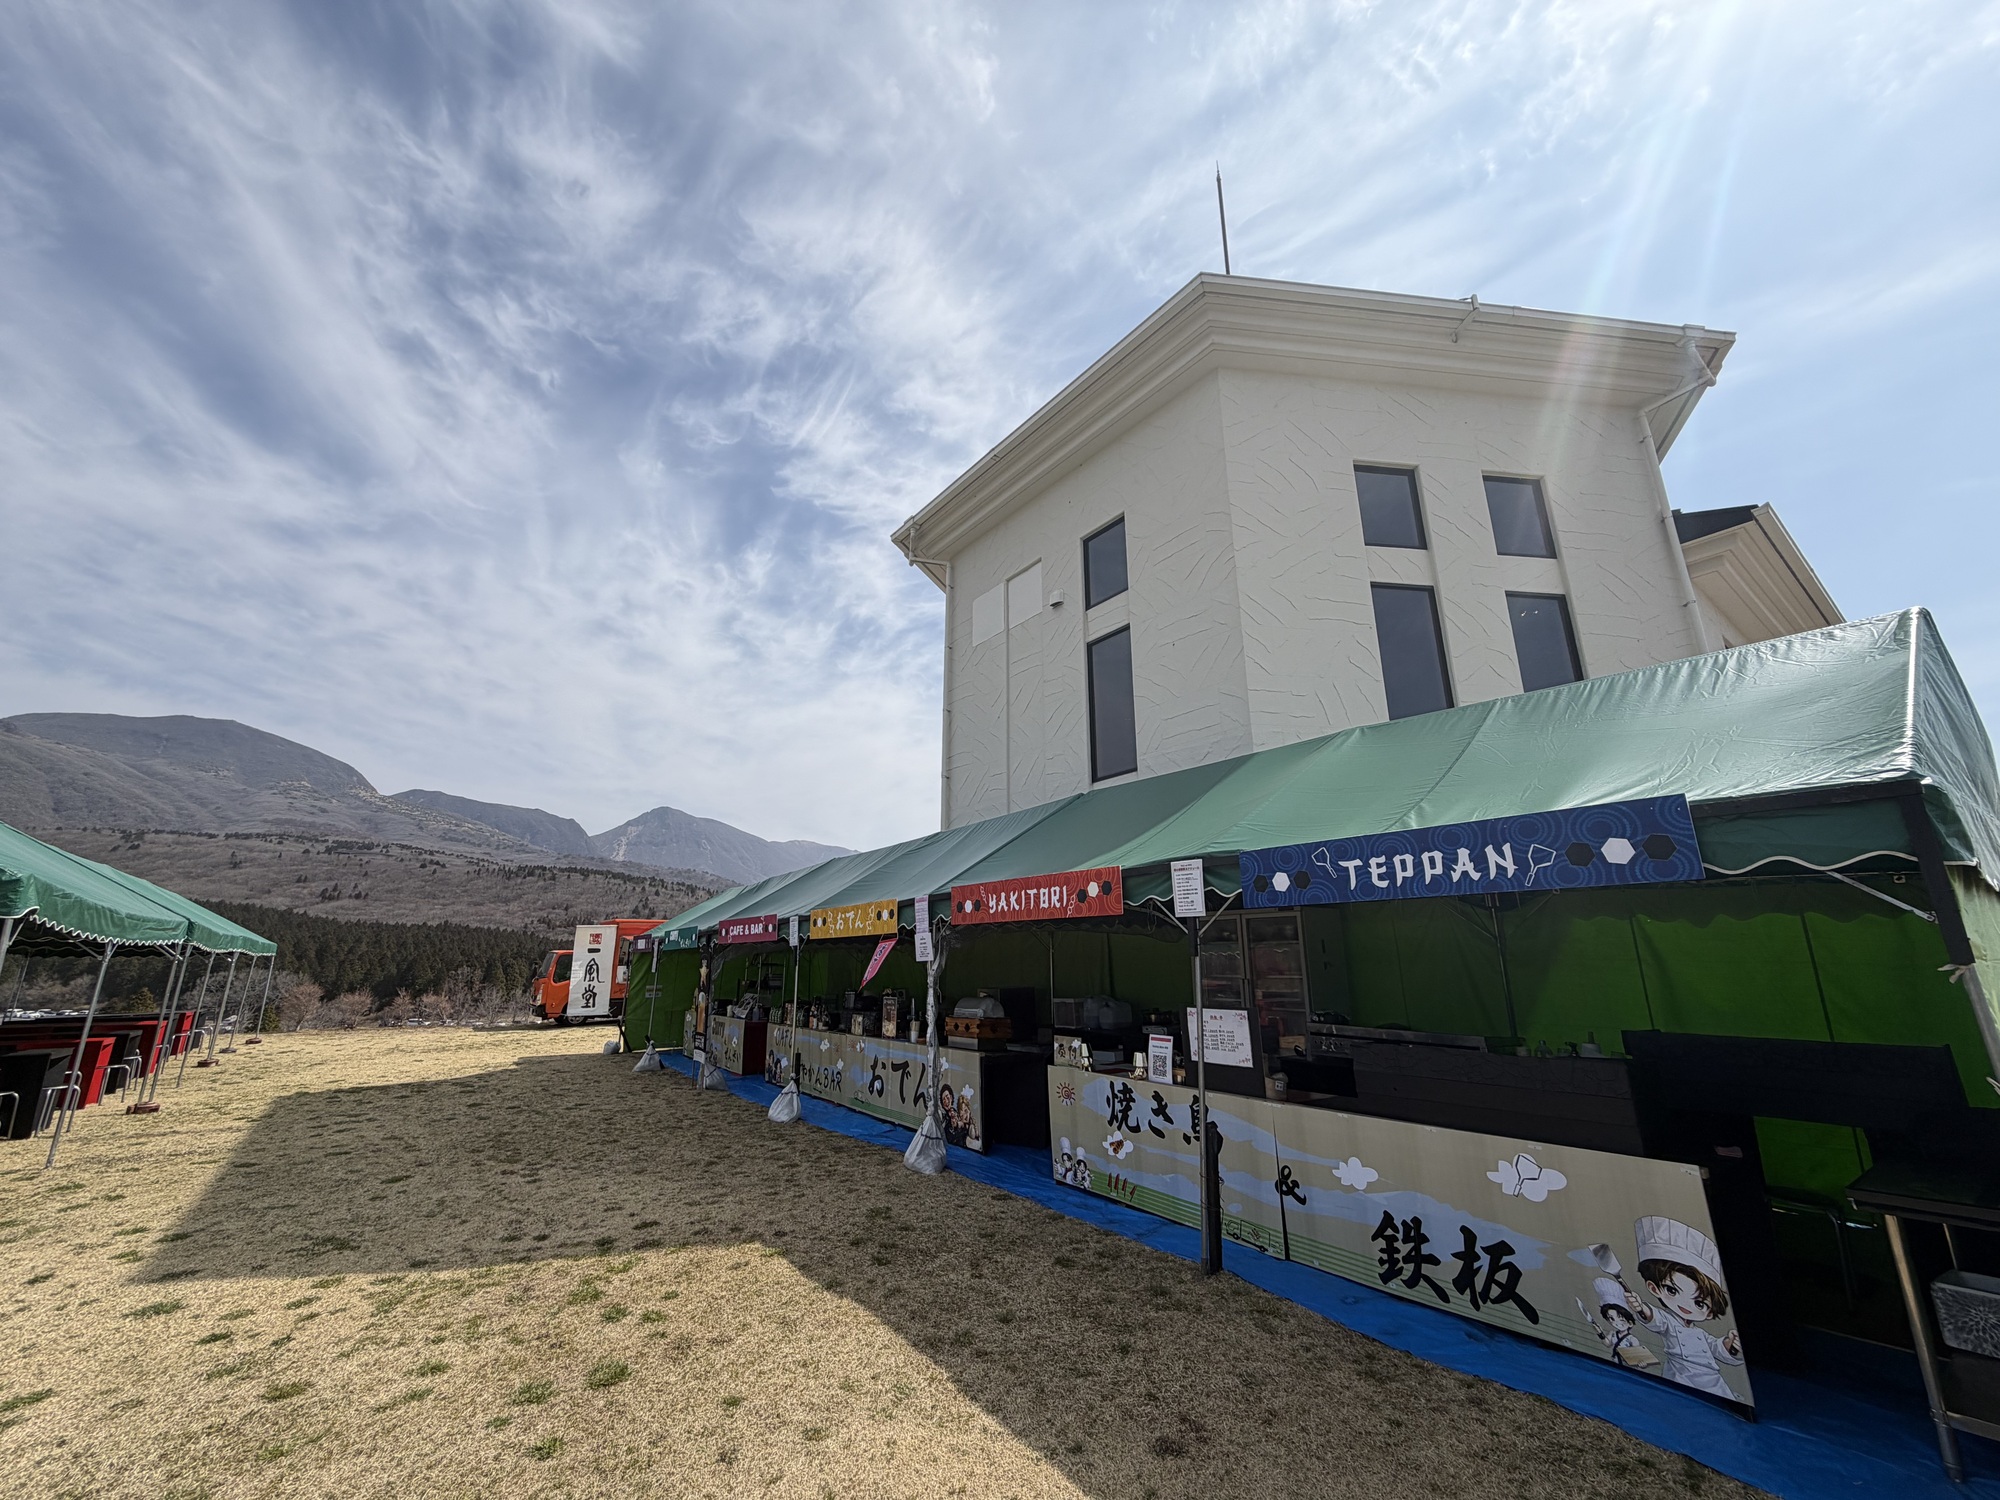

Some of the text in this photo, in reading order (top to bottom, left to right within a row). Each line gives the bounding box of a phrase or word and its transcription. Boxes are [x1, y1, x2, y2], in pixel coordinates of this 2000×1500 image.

[1339, 842, 1519, 891] TEPPAN
[835, 909, 864, 930] おでん
[987, 884, 1068, 914] YAKITORI
[729, 922, 764, 936] CAFE & BAR
[581, 947, 605, 1009] 一風堂
[868, 1054, 938, 1110] おでん
[1274, 1164, 1307, 1206] &
[1370, 1209, 1540, 1325] 鉄板
